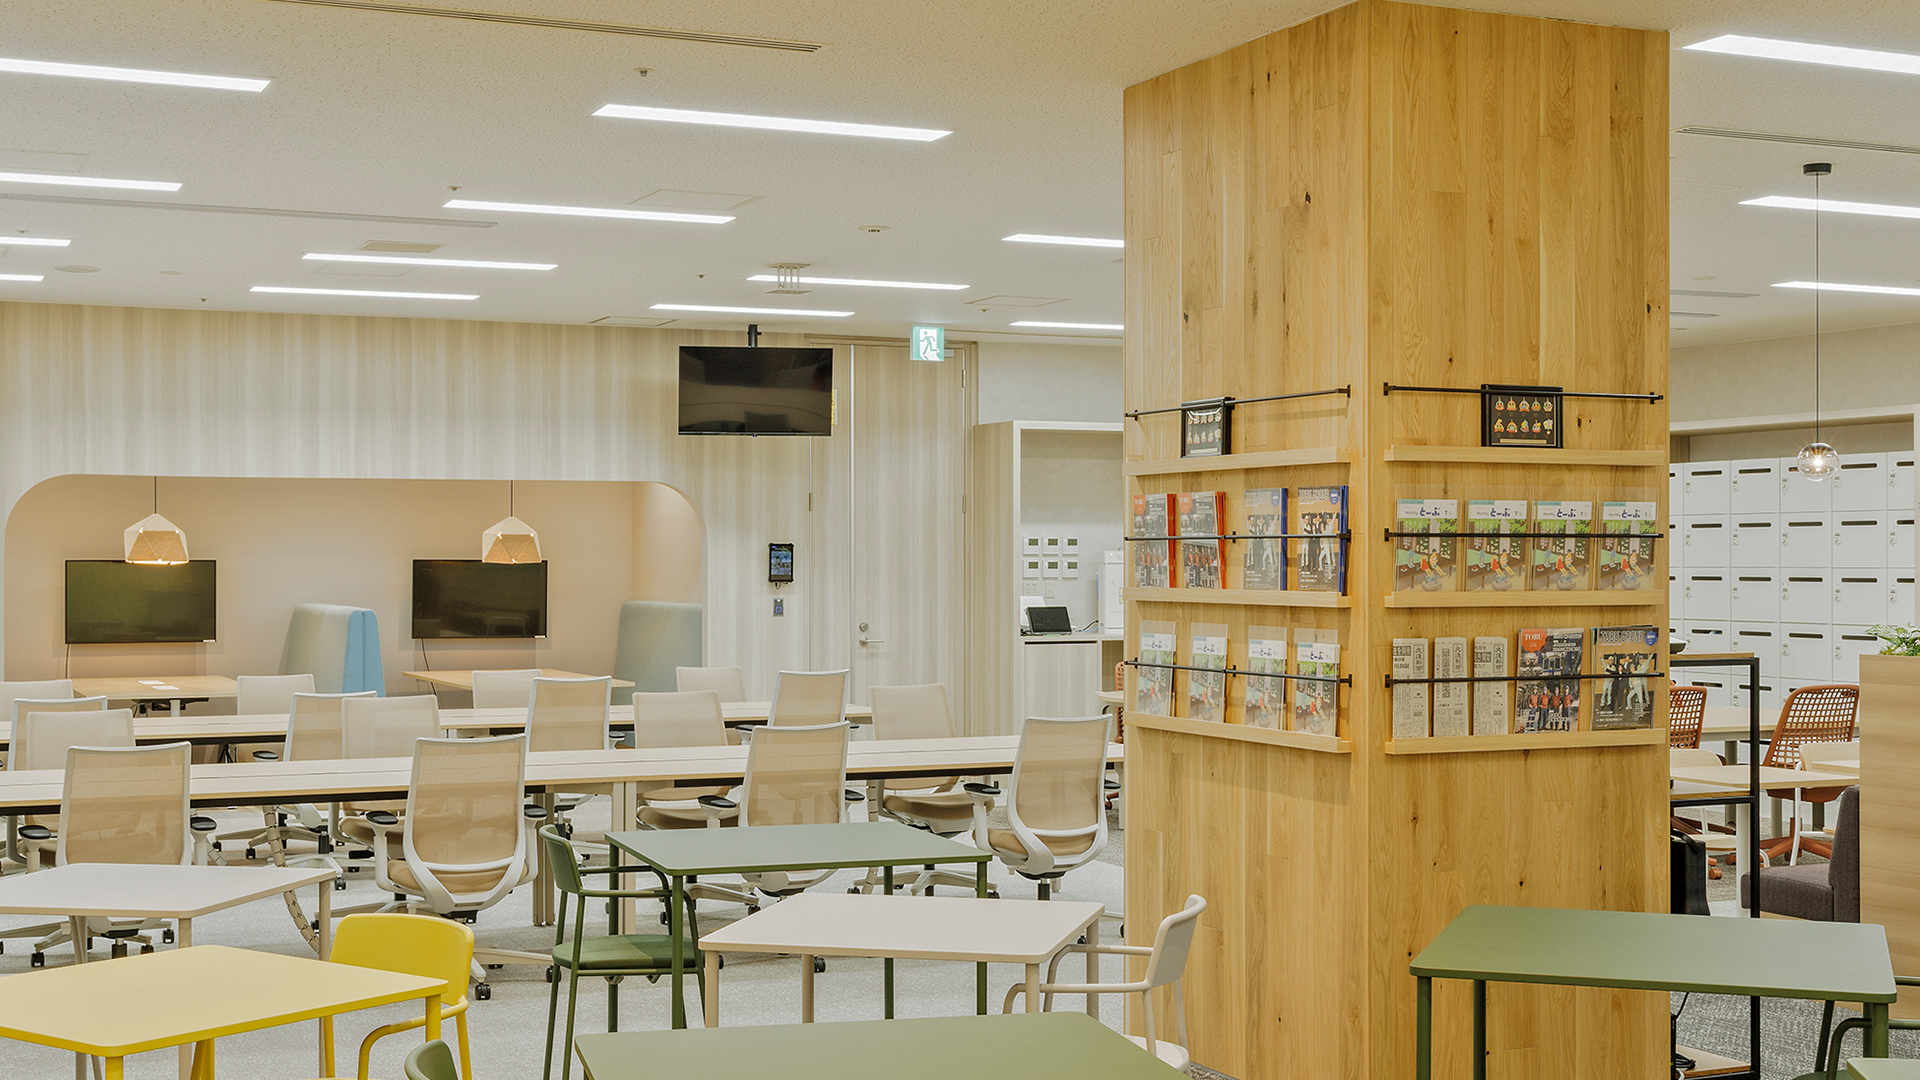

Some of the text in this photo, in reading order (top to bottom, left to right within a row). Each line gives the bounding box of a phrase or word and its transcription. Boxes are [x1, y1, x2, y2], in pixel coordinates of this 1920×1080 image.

[1419, 506, 1441, 517] とーぶ
[1490, 507, 1511, 518] とーぶ
[1556, 508, 1577, 518] とーぶ
[1621, 509, 1641, 519] とーぶ
[1524, 633, 1544, 641] TOBU
[1600, 630, 1620, 643] TOBU
[1620, 630, 1646, 643] GROUP
